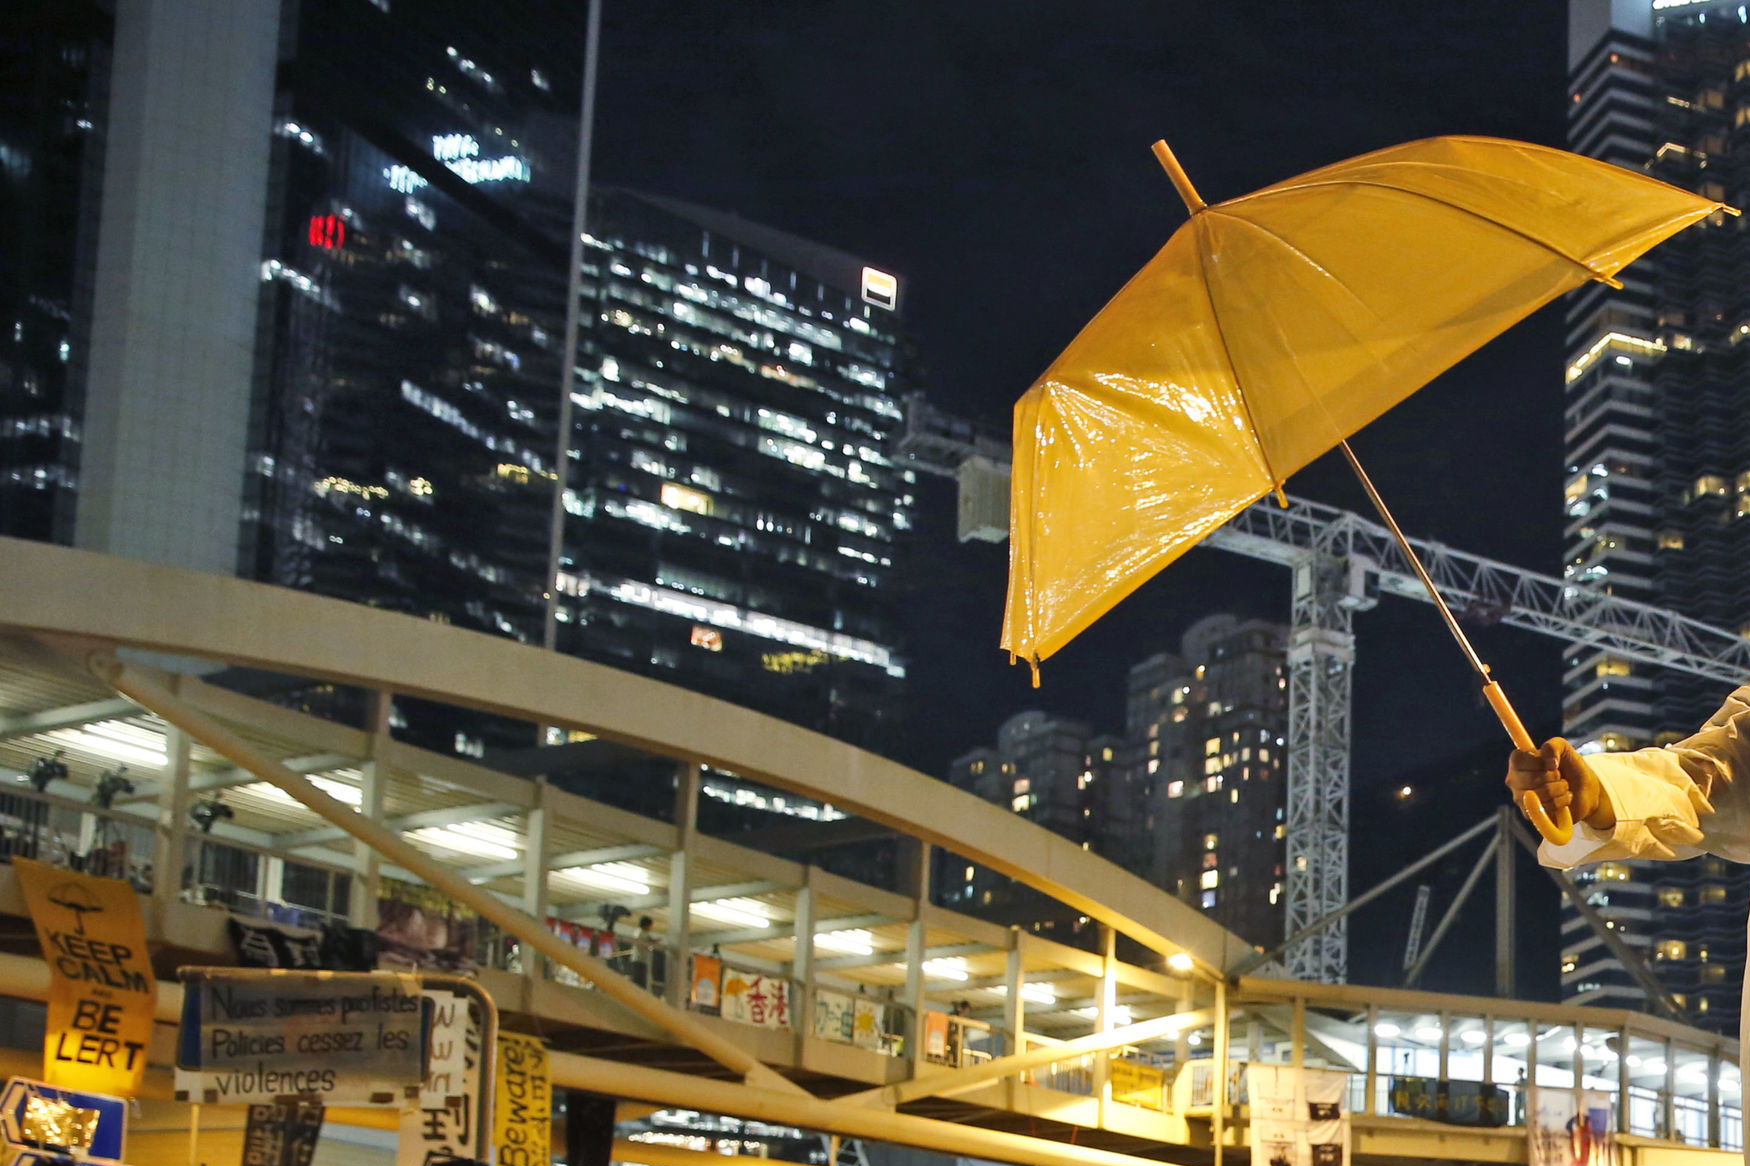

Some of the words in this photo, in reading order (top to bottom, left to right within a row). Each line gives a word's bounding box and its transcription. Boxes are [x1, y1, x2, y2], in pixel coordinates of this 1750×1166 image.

[46, 927, 133, 967] KEEP
[56, 956, 148, 994] CALM
[73, 999, 124, 1034] BE
[56, 1031, 145, 1072] LERT
[297, 1030, 364, 1054] cessez
[377, 1022, 409, 1051] les
[216, 1061, 337, 1095] violences
